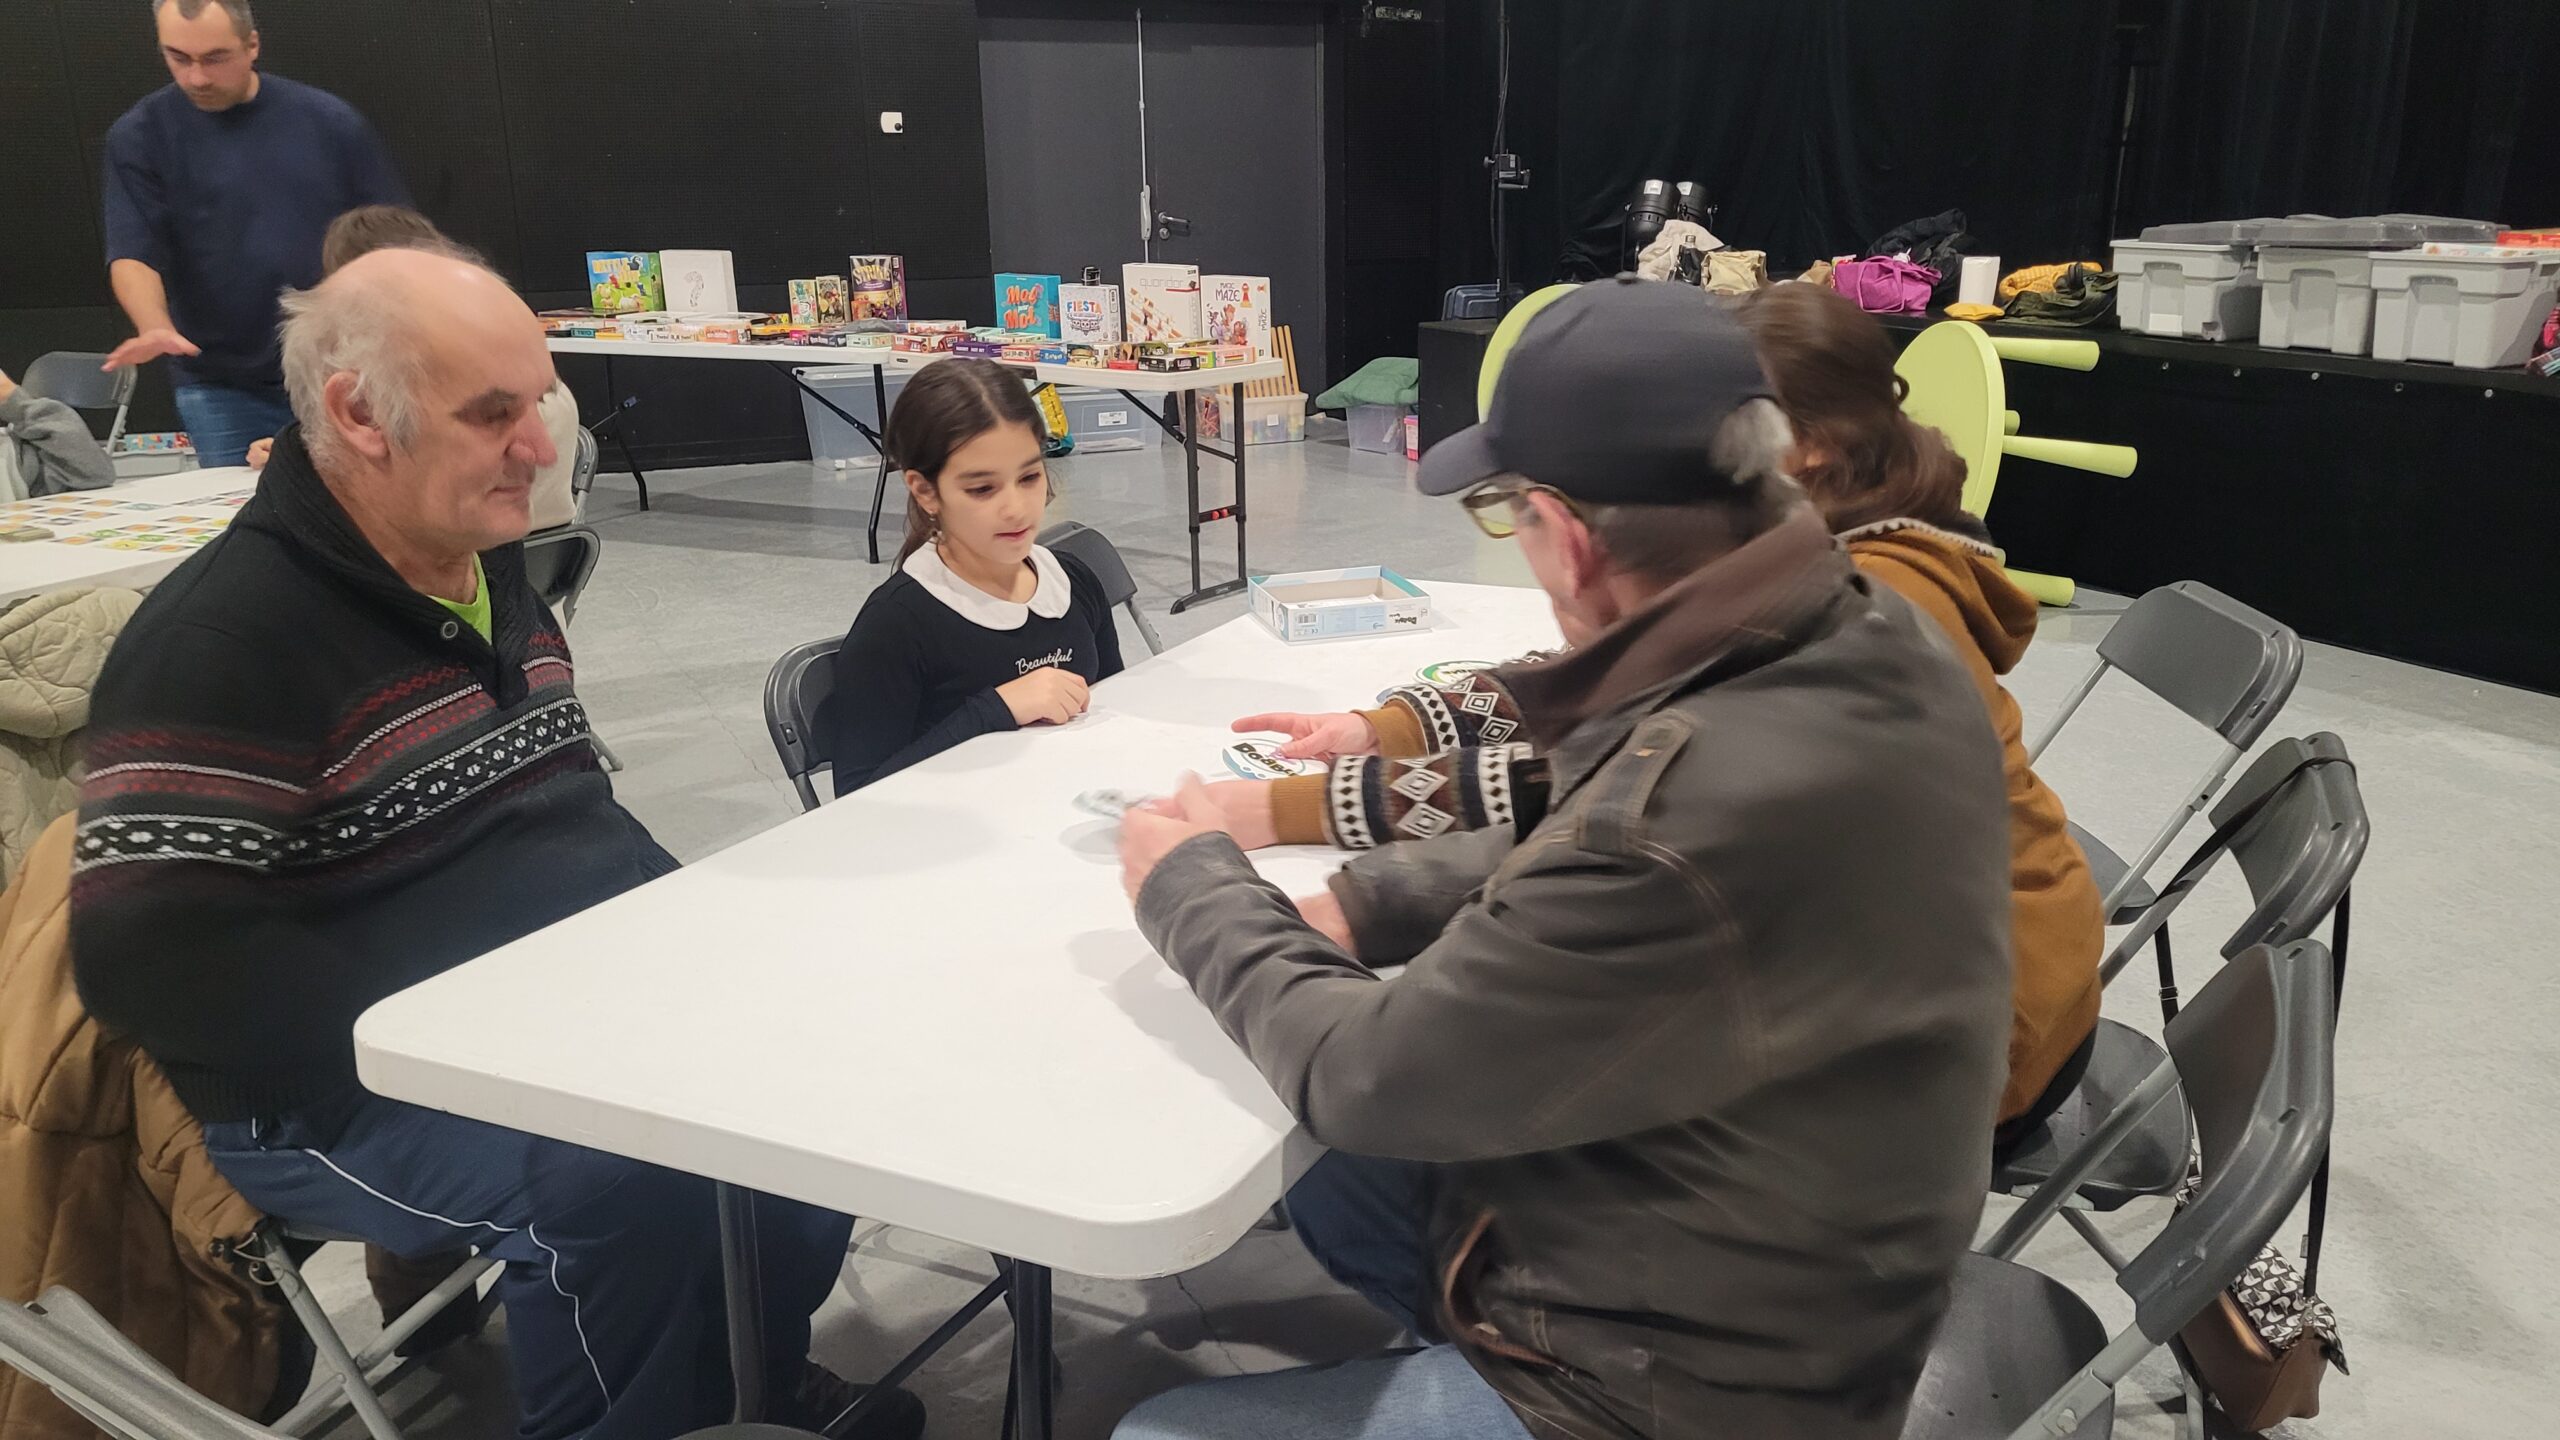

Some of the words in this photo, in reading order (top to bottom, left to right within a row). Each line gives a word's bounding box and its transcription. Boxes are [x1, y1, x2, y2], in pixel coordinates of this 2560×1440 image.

[852, 265, 891, 286] STRIKE
[1215, 289, 1241, 303] MAZE
[1066, 300, 1103, 314] FIESTA
[1015, 648, 1073, 675] Beautiful
